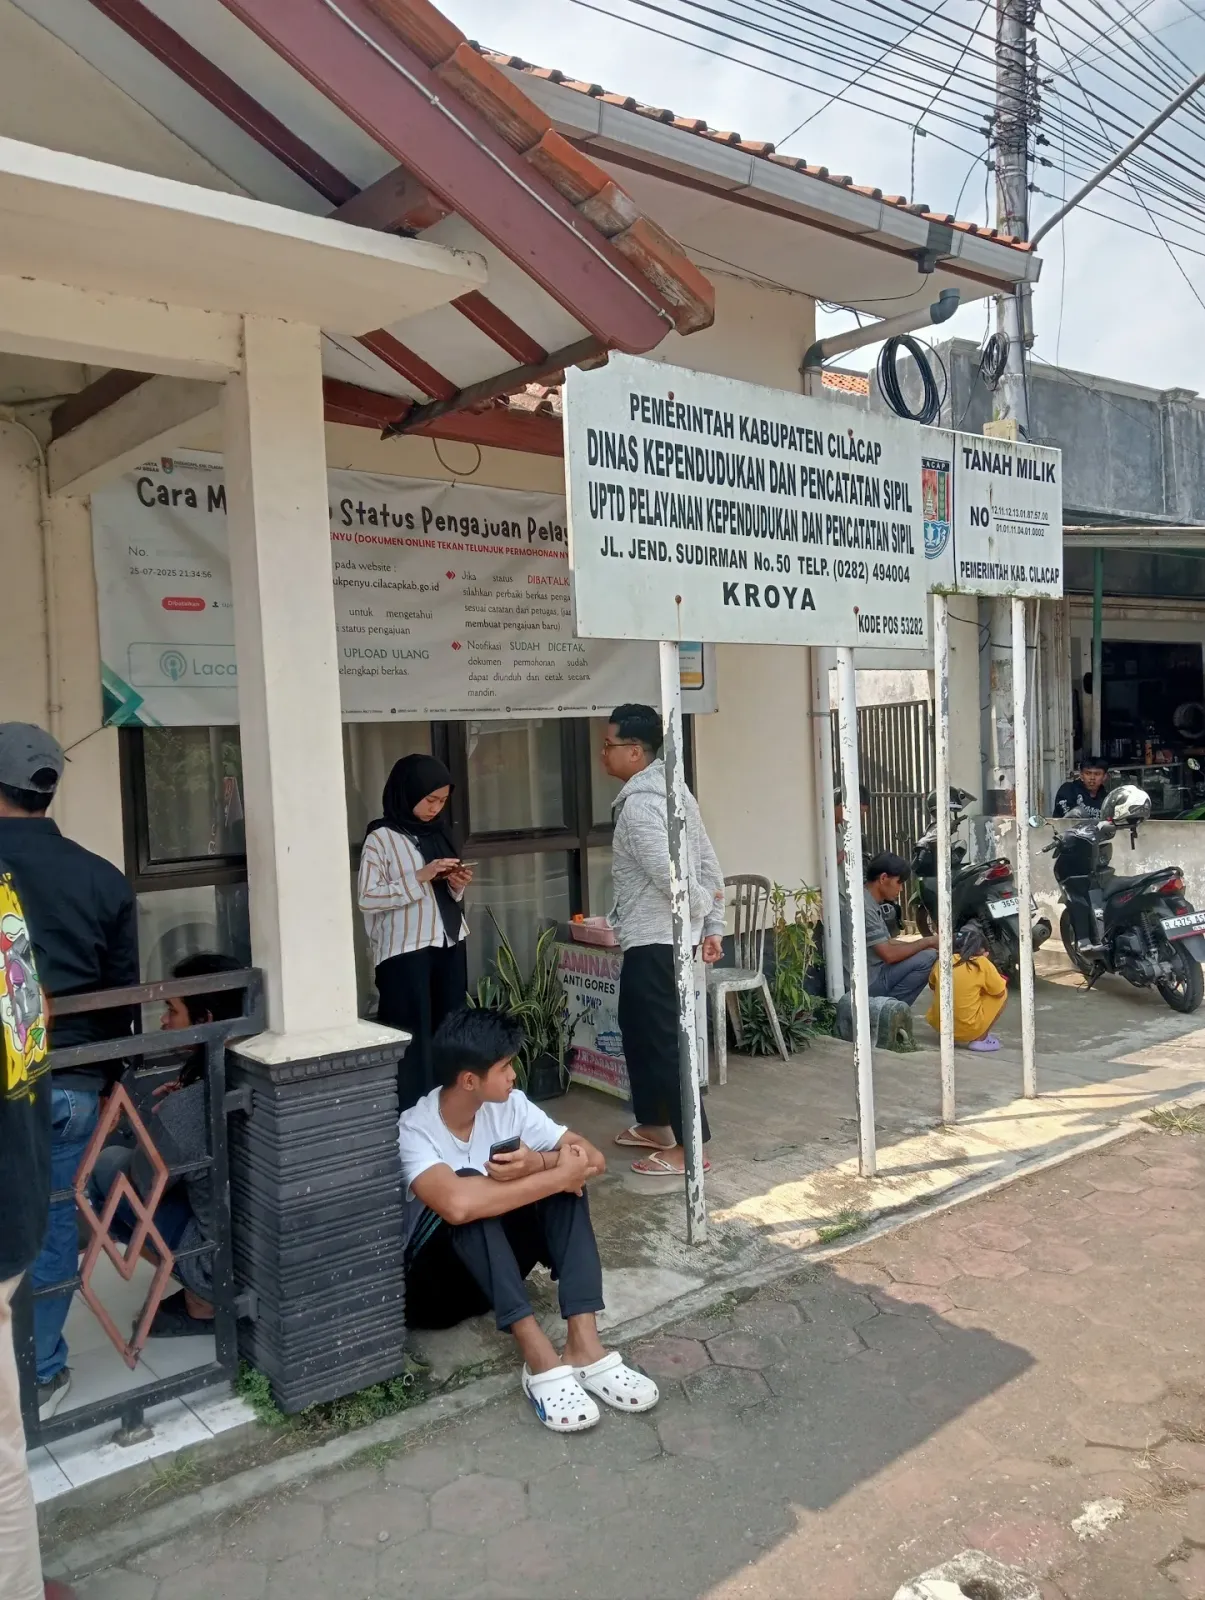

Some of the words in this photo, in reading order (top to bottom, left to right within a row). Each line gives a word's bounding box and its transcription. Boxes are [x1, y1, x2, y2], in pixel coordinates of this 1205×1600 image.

[629, 392, 734, 440] PEMERINTAH
[739, 415, 823, 456] KABUPATEN
[828, 433, 882, 466] CILACAP
[587, 428, 639, 473] DINAS
[643, 438, 765, 492] KEPENDUDUKAN
[769, 460, 796, 497] DAN
[800, 465, 881, 509] PENCATATAN
[883, 479, 913, 514] SIPIL
[963, 447, 1012, 477] TANAH
[1017, 457, 1056, 484] MILIK
[137, 476, 197, 508] Cara
[340, 498, 415, 530] Status
[421, 505, 522, 540] Pengajuan
[588, 480, 626, 523] UPTD
[629, 487, 703, 531] PELAYANAN
[706, 498, 798, 542] KEPENDUDUKAN
[802, 511, 823, 545] DAN
[826, 514, 889, 551] PENCATATAN
[891, 522, 915, 555] SIPIL
[970, 506, 990, 528] NO
[128, 545, 149, 557] No.
[354, 532, 404, 546] (DOKUMEN
[405, 538, 435, 549] ONLINE
[438, 541, 464, 551] TEKAN
[465, 543, 504, 554] TELUNJUK
[505, 546, 558, 559] PERMOHONAN
[335, 560, 356, 570] pada
[359, 561, 391, 572] website
[600, 535, 624, 558] JL.
[628, 538, 672, 562] JEND.
[676, 543, 748, 570] SUDIRMAN
[798, 556, 830, 577] TELP.
[833, 559, 869, 584] (0282)
[872, 563, 910, 583] 494004
[130, 567, 177, 577] 25-07-2025
[461, 570, 477, 581] Jika
[492, 575, 514, 583] status
[527, 575, 570, 586] DIBATALK
[960, 561, 1008, 581] PEMERINTAH
[1010, 565, 1027, 582] KAB.
[1029, 566, 1060, 584] CILACAP
[463, 587, 493, 597] silahkan
[496, 589, 523, 600] perbaiki
[525, 590, 548, 600] berkas
[722, 581, 816, 611] KROYA
[349, 607, 374, 617] untuk
[386, 610, 433, 620] mengetahui
[464, 604, 487, 612] sesuai
[488, 606, 514, 614] catatan
[341, 625, 366, 633] status
[368, 625, 411, 636] pengajuan
[465, 619, 501, 628] membuat
[503, 620, 540, 631] pengajuan
[858, 614, 881, 634] KODE
[883, 615, 899, 635] POS
[900, 616, 923, 635] 53282
[343, 648, 388, 659] UPLOAD
[392, 649, 430, 660] ULANG
[509, 641, 540, 651] SUDAH
[381, 665, 409, 676] berkas.
[467, 657, 502, 666] dokumen
[513, 659, 556, 668] permohonan
[567, 658, 589, 667] sudah
[468, 672, 489, 682] dapat
[526, 672, 540, 681] dan
[544, 672, 564, 681] cetak
[563, 974, 583, 988] ANTI
[584, 979, 616, 995] GORES
